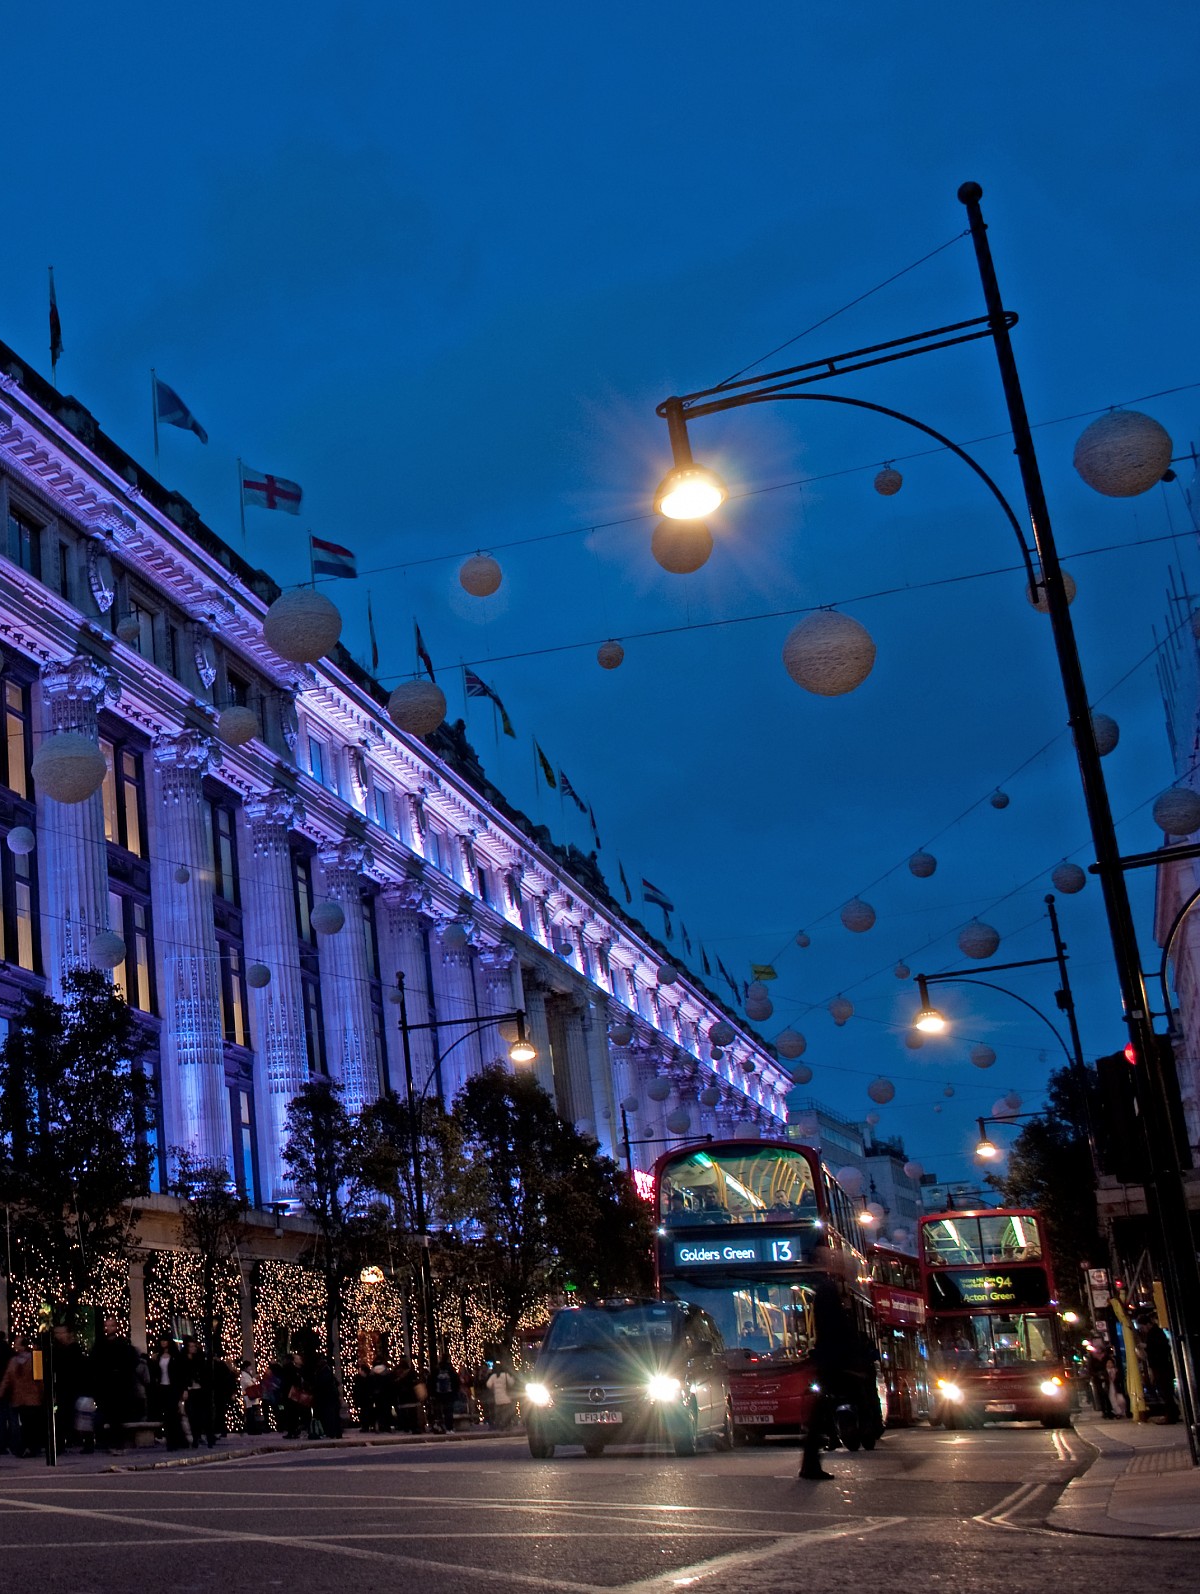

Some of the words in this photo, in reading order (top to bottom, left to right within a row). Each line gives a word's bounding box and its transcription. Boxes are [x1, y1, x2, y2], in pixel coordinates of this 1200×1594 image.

[680, 1248, 720, 1261] Golders
[723, 1247, 755, 1260] Green
[772, 1240, 792, 1261] 13
[995, 1276, 1012, 1288] 94
[963, 1293, 988, 1301] Acton
[990, 1292, 1016, 1300] Green
